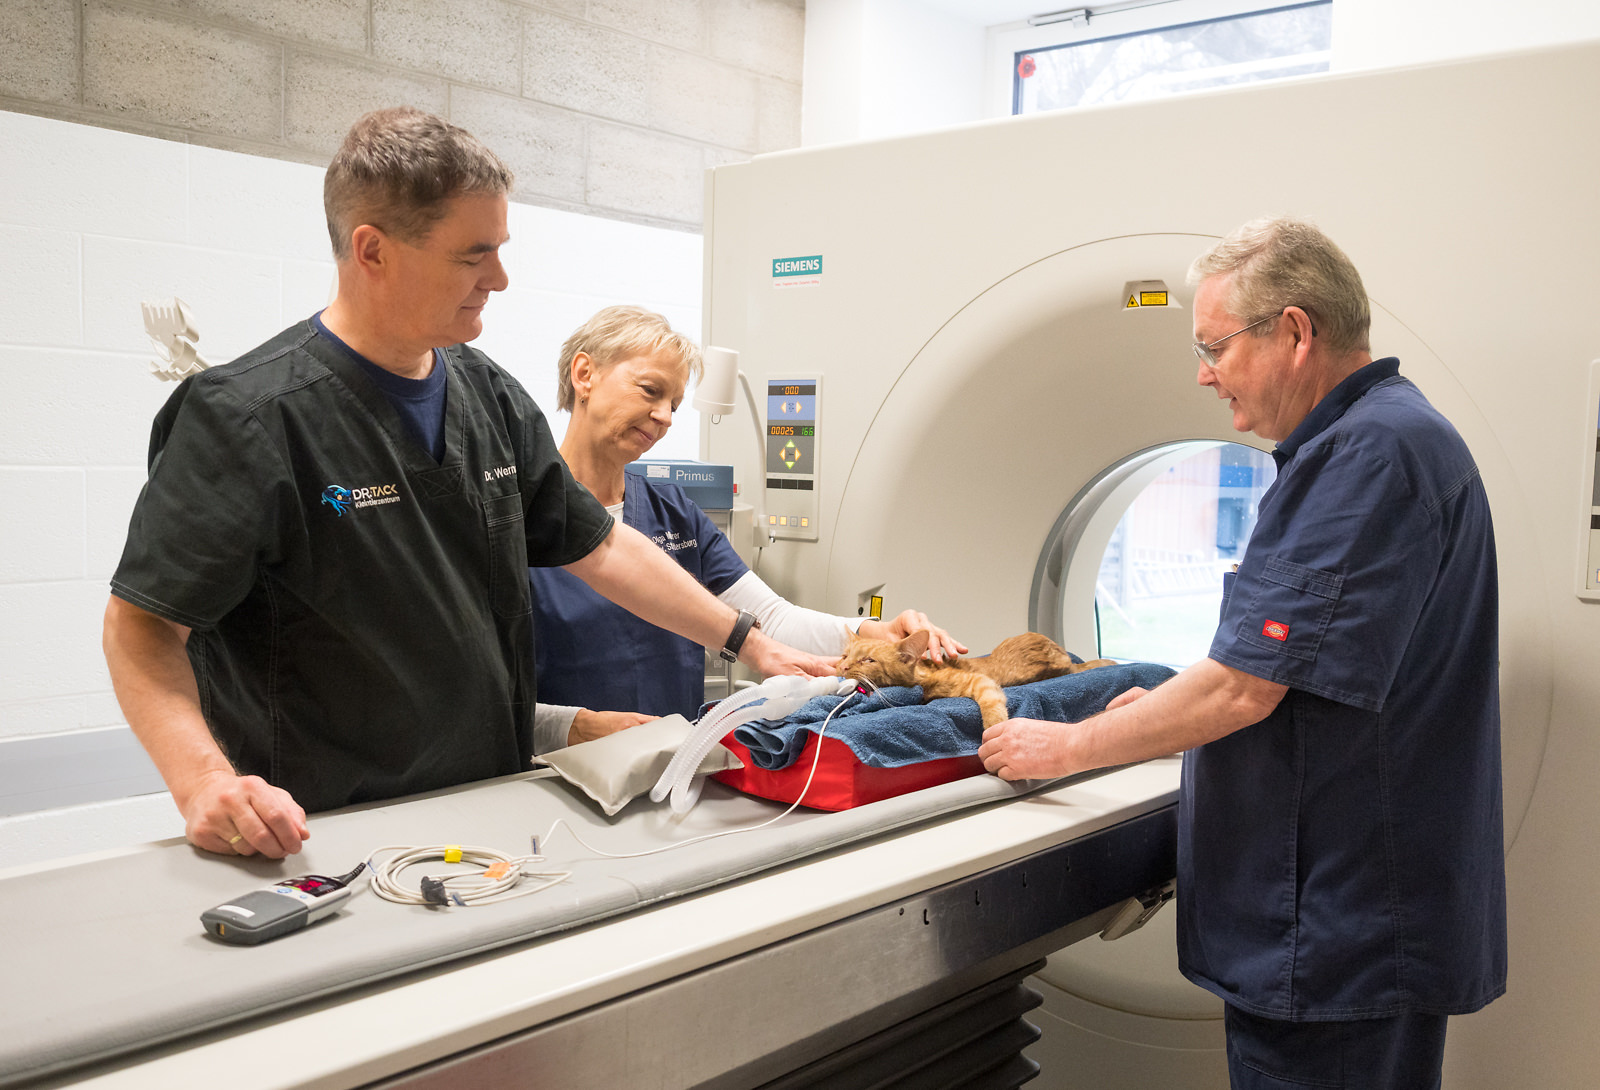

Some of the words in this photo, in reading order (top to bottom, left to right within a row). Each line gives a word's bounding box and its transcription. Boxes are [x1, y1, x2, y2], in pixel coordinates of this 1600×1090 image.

[774, 259, 820, 273] SIEMENS
[771, 426, 794, 435] 00025
[802, 427, 814, 436] 166
[484, 470, 494, 481] Dr.
[676, 470, 715, 481] Primus
